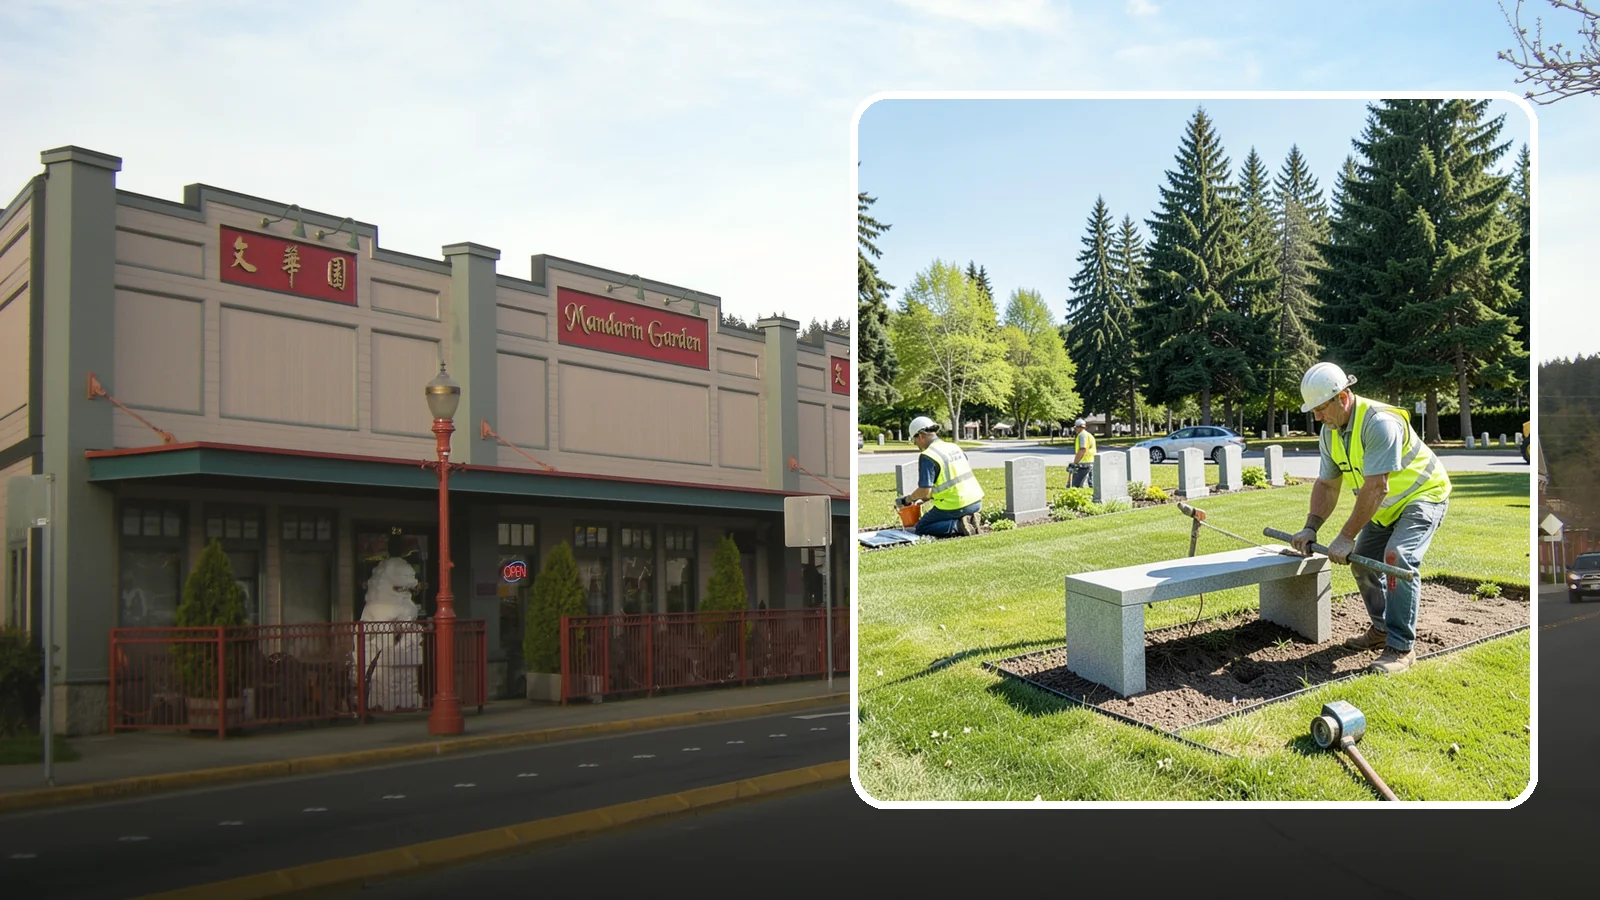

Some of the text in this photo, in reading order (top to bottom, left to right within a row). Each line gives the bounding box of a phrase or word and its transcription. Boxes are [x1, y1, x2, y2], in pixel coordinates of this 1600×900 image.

[231, 235, 346, 291] 文華園
[564, 302, 701, 352] Mandarin Garden
[503, 565, 527, 578] OPEN
